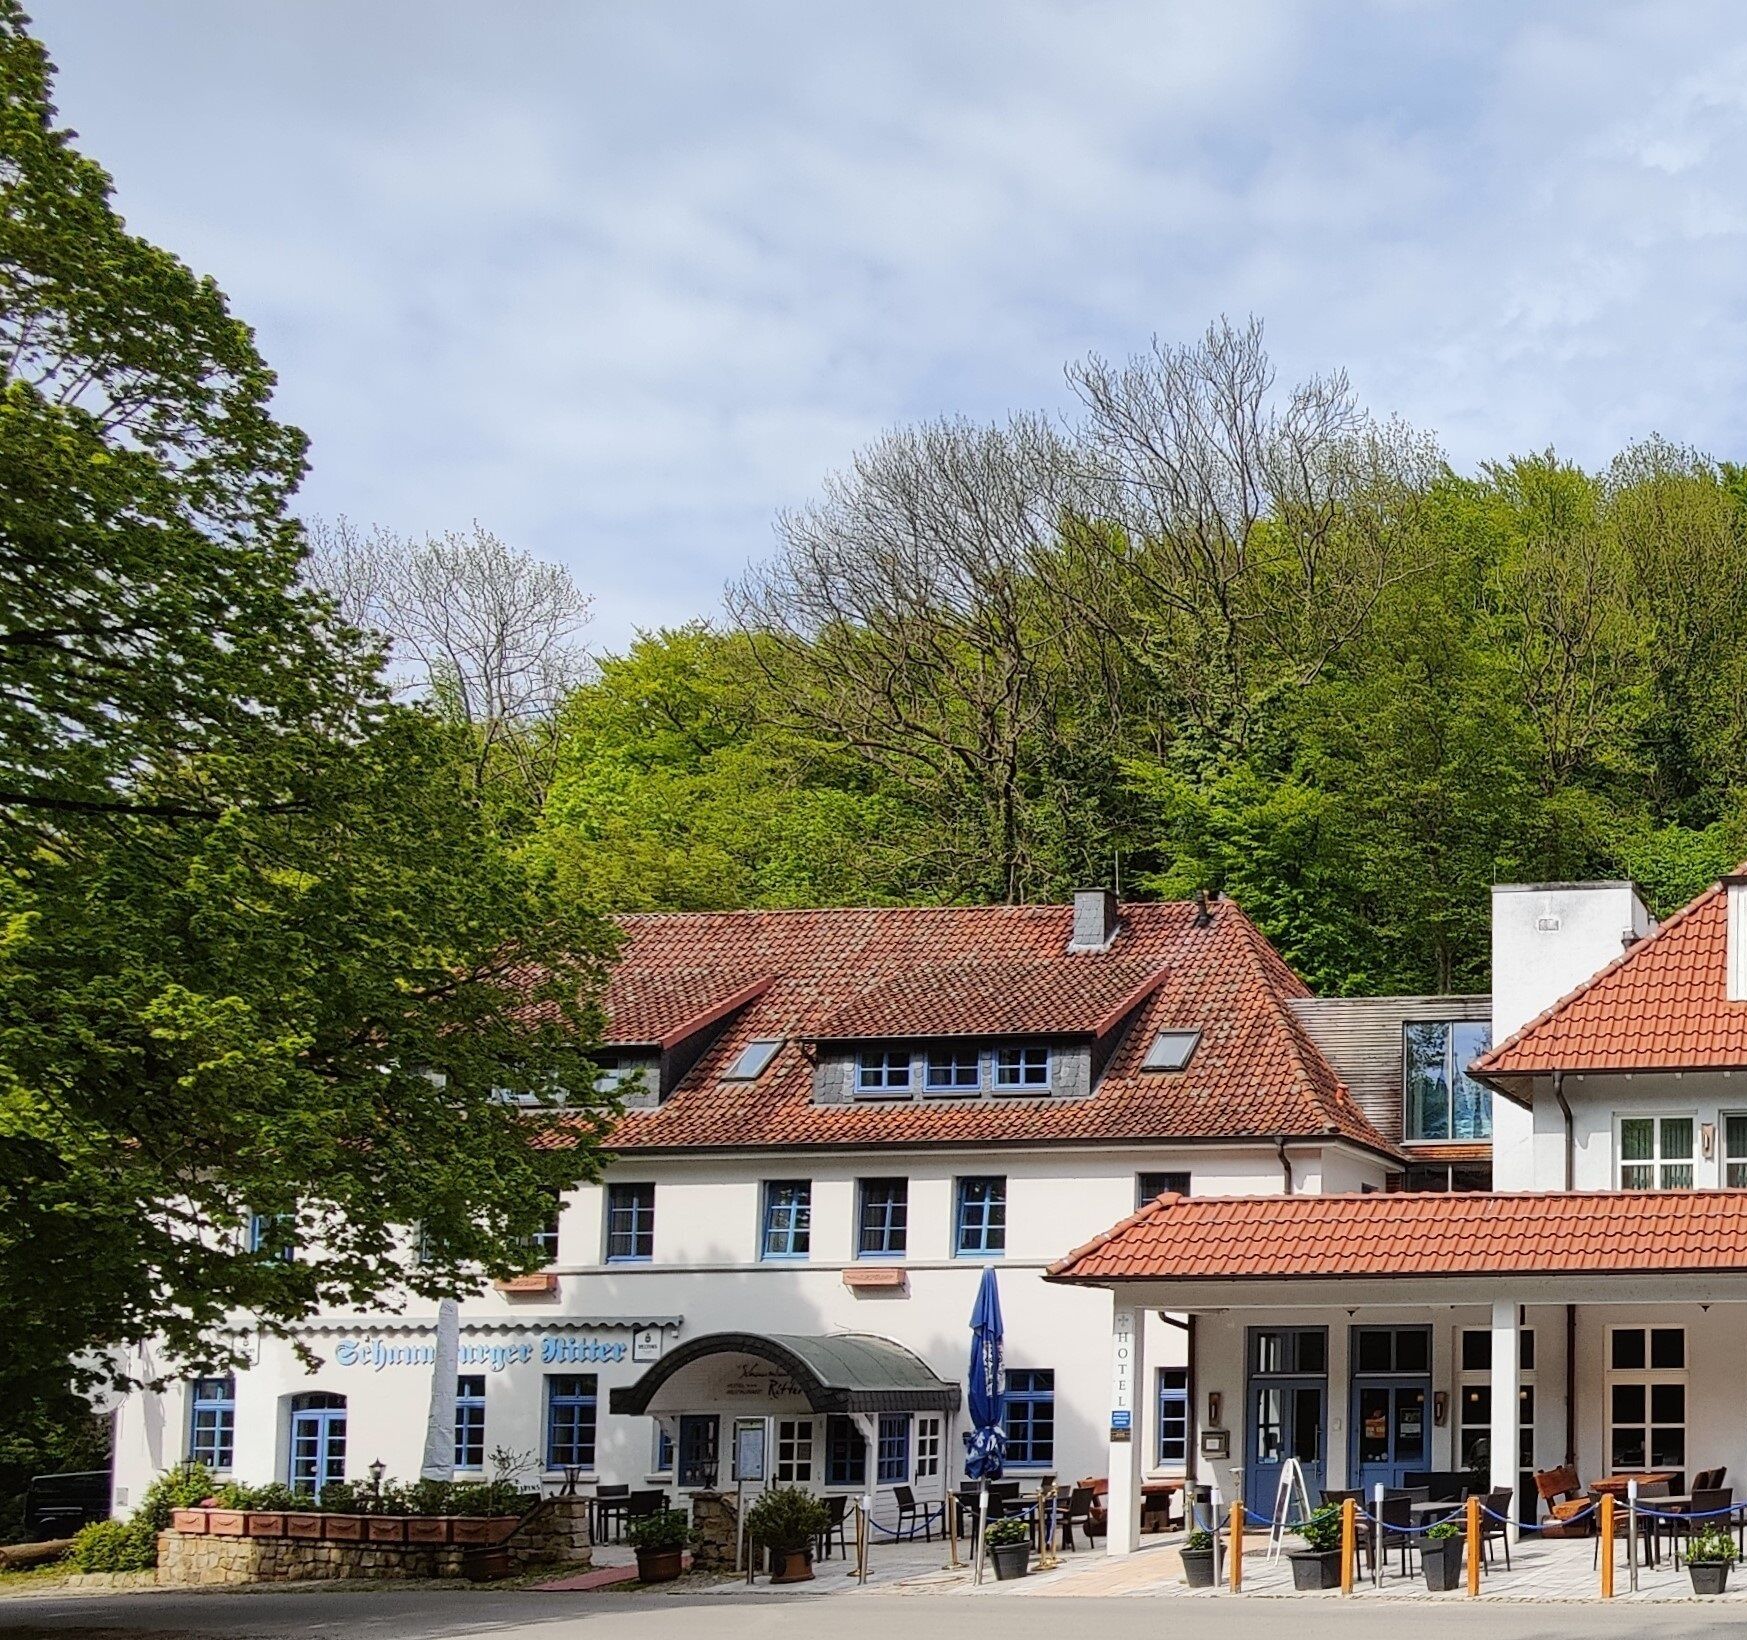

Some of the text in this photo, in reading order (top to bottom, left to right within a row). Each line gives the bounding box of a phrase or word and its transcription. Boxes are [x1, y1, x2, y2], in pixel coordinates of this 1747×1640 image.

[335, 1336, 628, 1372] Schaumurger Ritter
[1118, 1332, 1128, 1406] HOTEL
